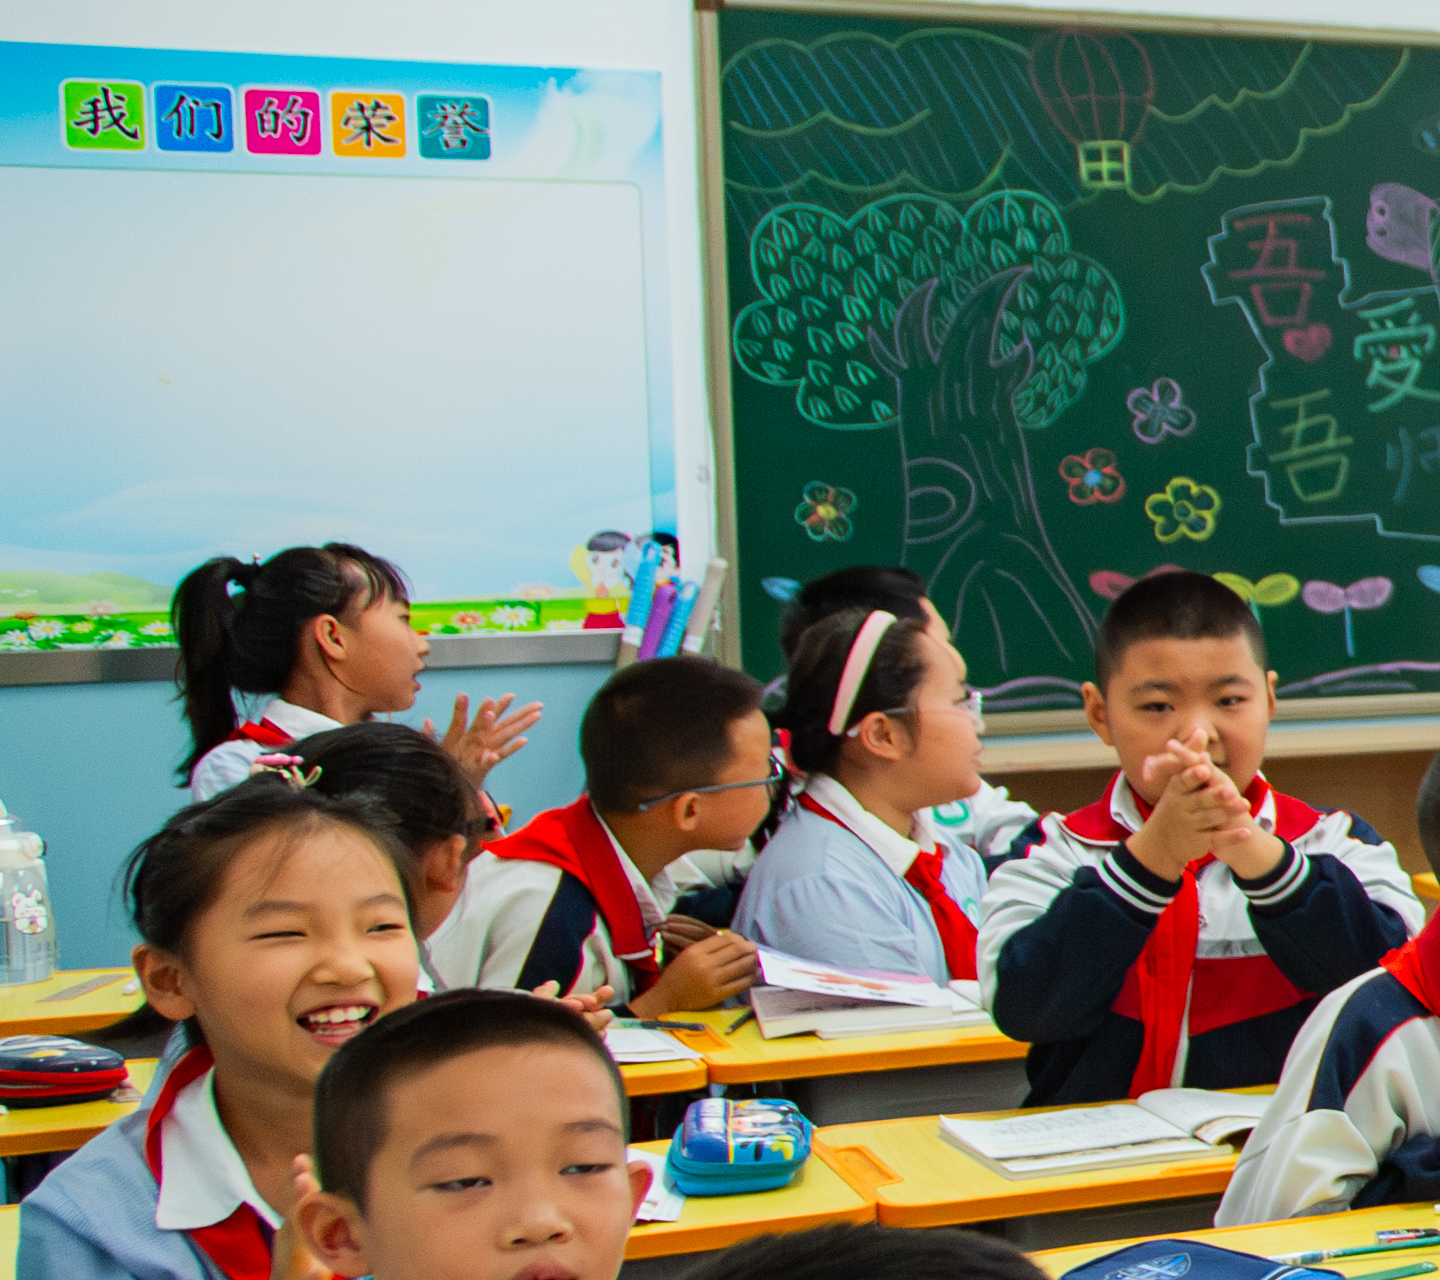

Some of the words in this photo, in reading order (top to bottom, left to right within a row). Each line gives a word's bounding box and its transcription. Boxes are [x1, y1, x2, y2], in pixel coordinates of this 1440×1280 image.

[73, 90, 490, 153] 我们的荣誉
